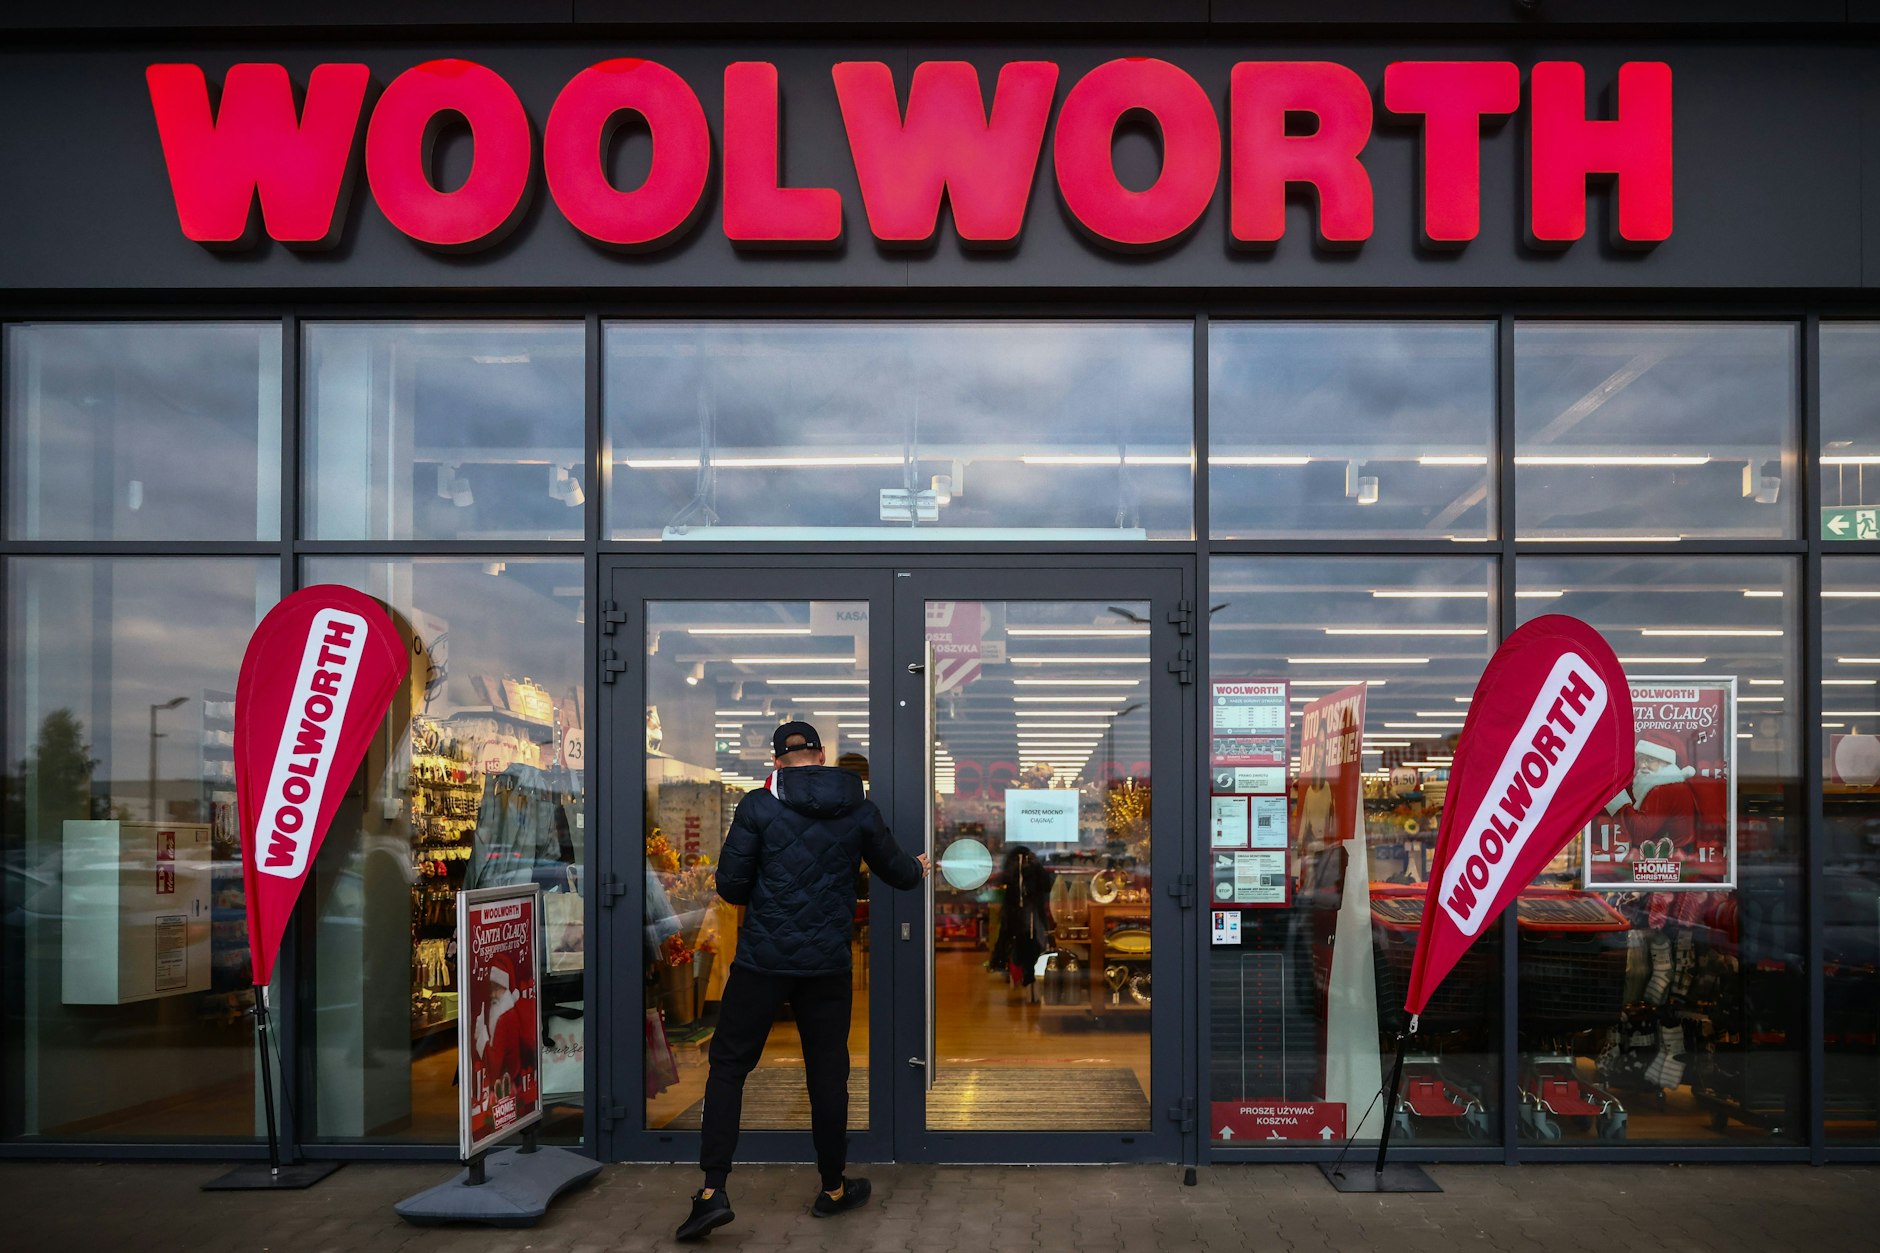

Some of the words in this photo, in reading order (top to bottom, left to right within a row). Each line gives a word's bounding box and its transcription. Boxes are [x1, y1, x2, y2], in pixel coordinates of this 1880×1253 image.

[145, 57, 1673, 245] WOOLWORTH
[836, 611, 869, 621] KASA
[925, 632, 953, 644] OSZĘ
[1216, 686, 1279, 695] WOOLWORTH
[1630, 689, 1695, 699] OOLWORTH
[1659, 704, 1713, 728] CLAUS
[1304, 710, 1320, 741] OTO
[1634, 721, 1671, 733] OPPING
[1672, 721, 1685, 730] AT
[1686, 721, 1699, 730] US
[264, 619, 356, 868] WOOLWORTH
[1393, 774, 1415, 786] 4.50
[1446, 669, 1596, 921] WOOLWORTH
[1638, 863, 1676, 873] HOME
[483, 904, 520, 920] WOOLWORTH
[472, 925, 501, 954] SANTA
[502, 922, 527, 945] CLAUS
[495, 1100, 515, 1119] HOME
[1240, 1107, 1276, 1117] PROSZĘ
[1276, 1105, 1315, 1115] UŻYWAĆ
[1256, 1117, 1299, 1125] KOSZYKA
